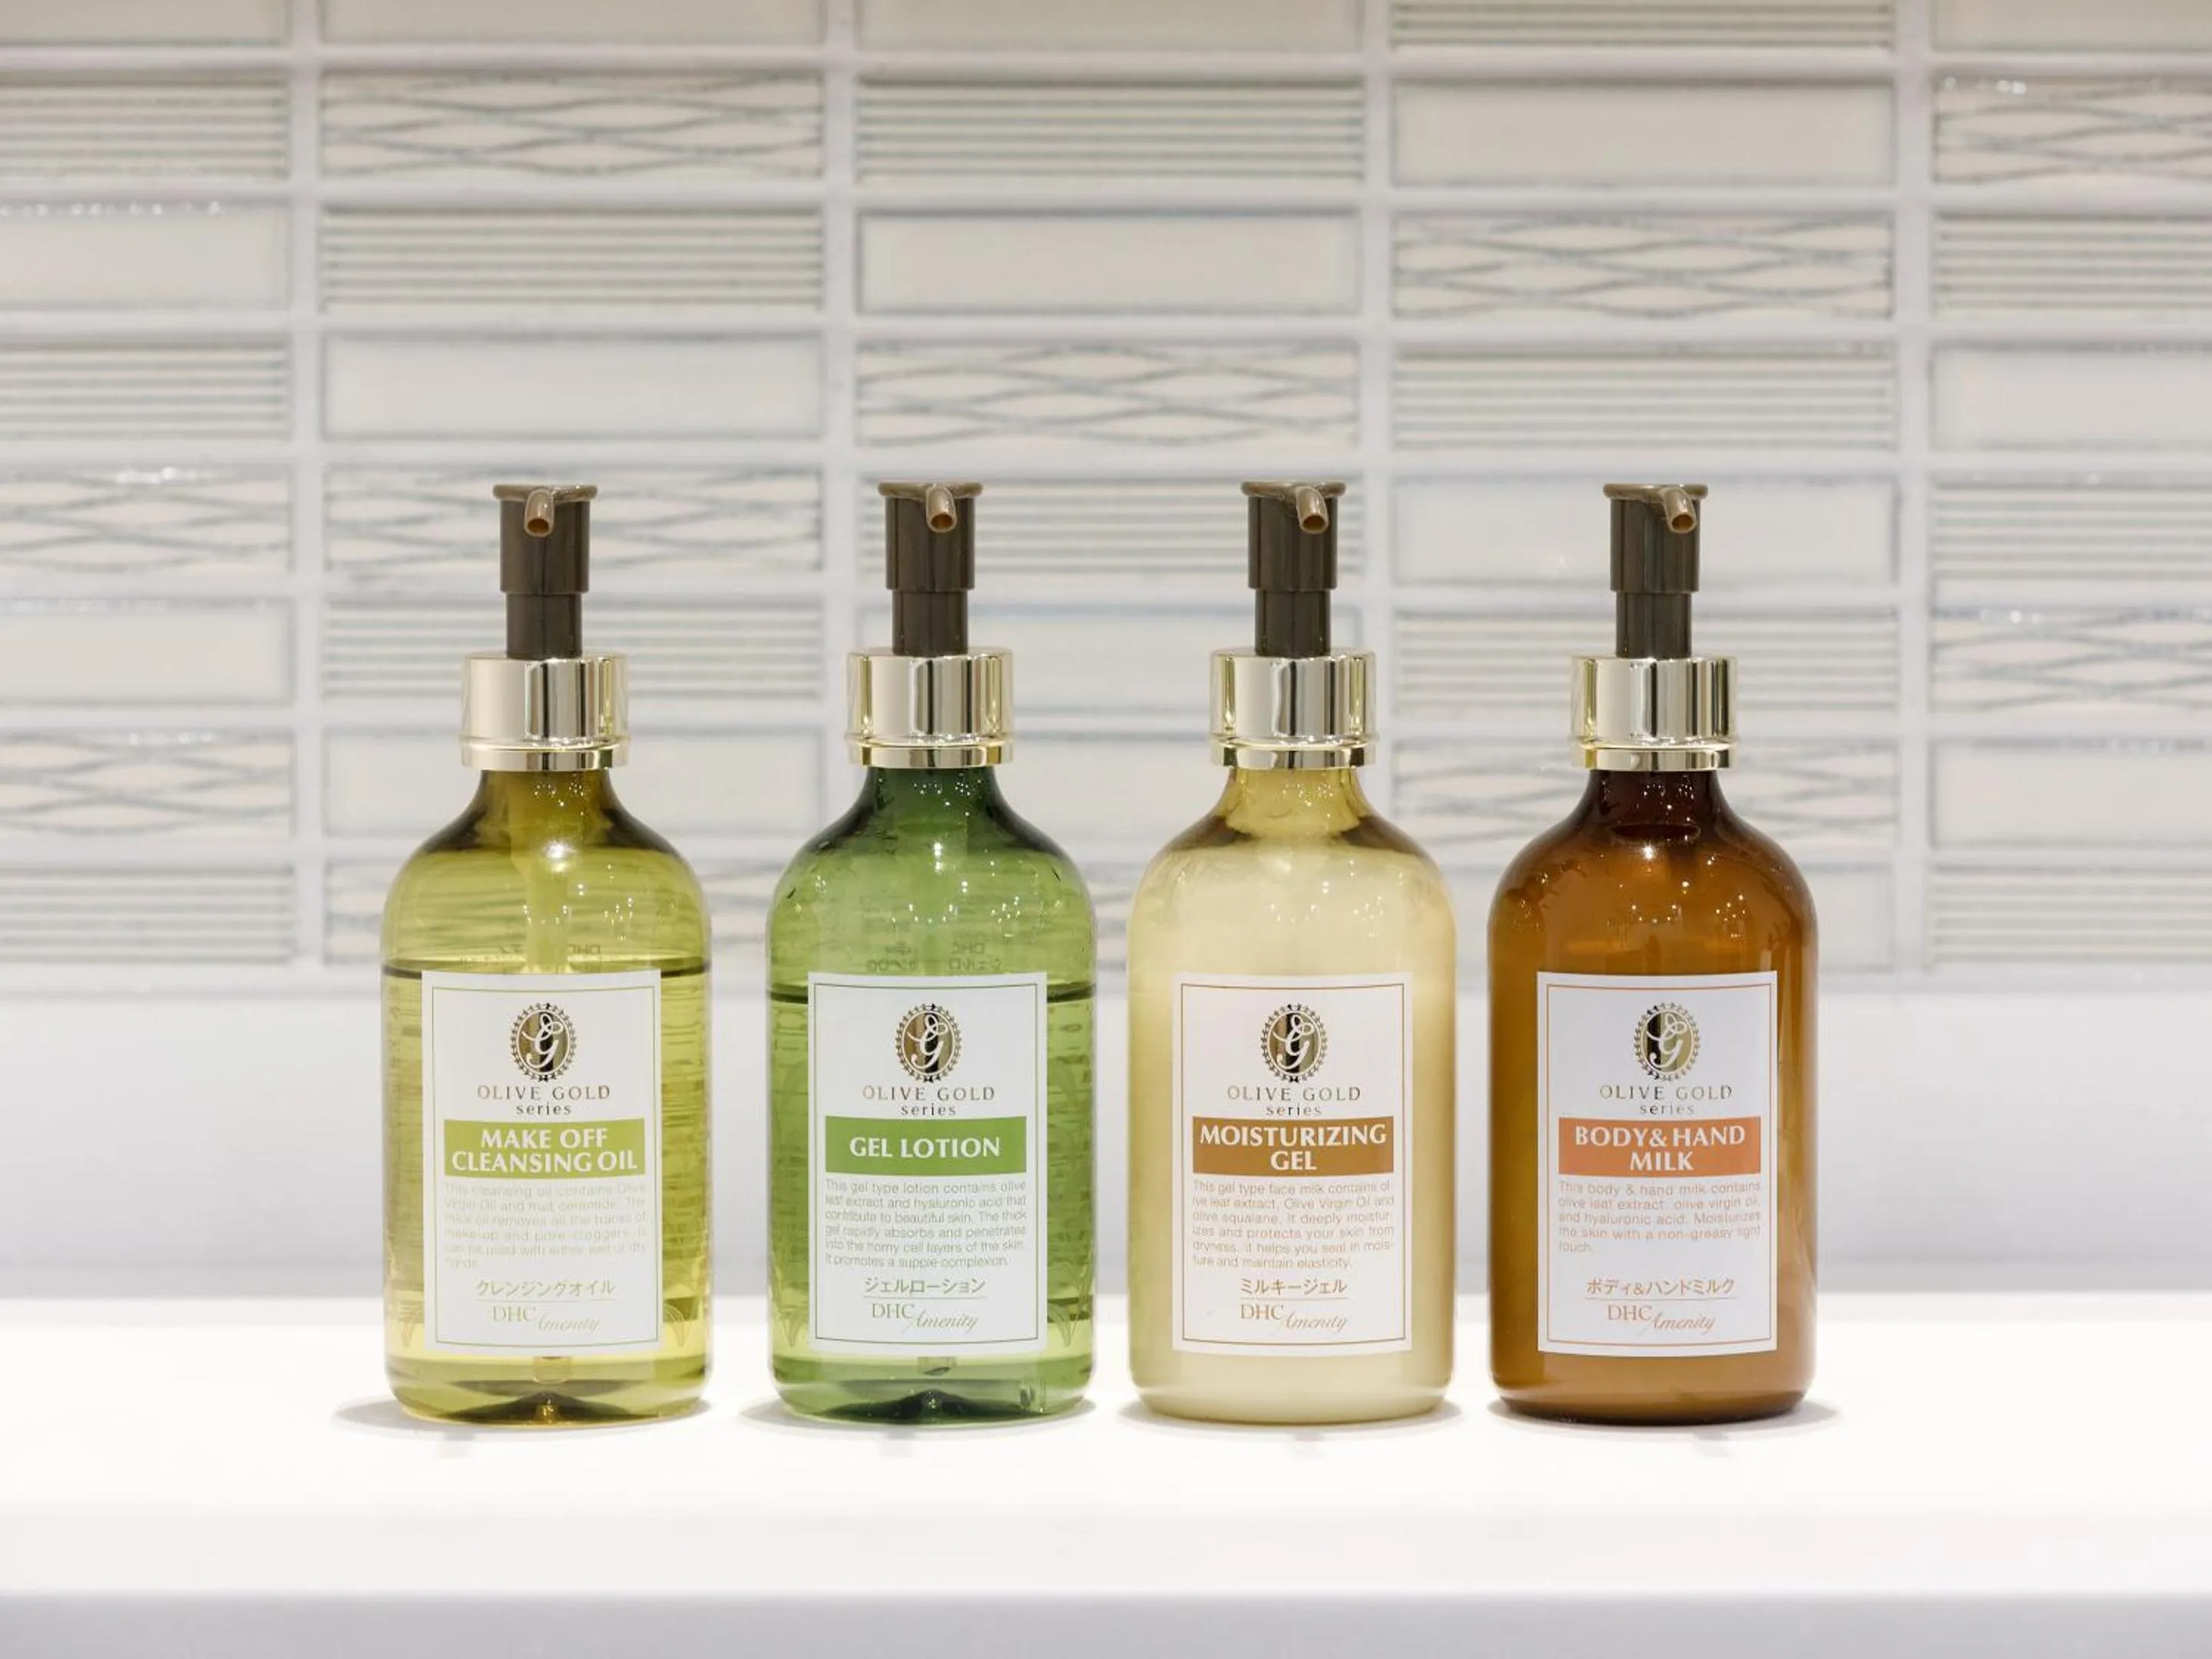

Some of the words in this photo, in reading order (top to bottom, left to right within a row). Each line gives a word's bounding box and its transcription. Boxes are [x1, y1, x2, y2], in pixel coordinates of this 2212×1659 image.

[477, 1084, 541, 1100] OLIVE
[552, 1084, 611, 1101] GOLD
[862, 1085, 926, 1101] OLIVE
[937, 1086, 995, 1101] GOLD
[1227, 1085, 1292, 1101] OLIVE
[1303, 1086, 1361, 1101] GOLD
[1598, 1084, 1664, 1100] OLIVE
[1675, 1084, 1733, 1100] GOLD
[516, 1101, 571, 1115] series
[901, 1102, 956, 1116] series
[1266, 1102, 1322, 1116] series
[1639, 1101, 1695, 1115] series
[481, 1128, 551, 1149] MAKE
[559, 1127, 608, 1149] OFF
[1200, 1124, 1387, 1147] MOISTURIZING
[849, 1136, 893, 1157] GEL
[900, 1137, 1002, 1159] LOTION
[452, 1150, 591, 1173] CLEANSING
[597, 1149, 637, 1171] OIL
[1270, 1151, 1318, 1171] GEL
[1630, 1151, 1694, 1171] MILK
[850, 1182, 868, 1194] gel
[872, 1183, 899, 1196] type
[903, 1182, 939, 1194] lotion
[943, 1184, 996, 1194] contains
[1001, 1181, 1026, 1192] olive
[1217, 1182, 1235, 1195] gel
[1239, 1183, 1265, 1196] type
[1269, 1183, 1295, 1194] face
[1300, 1183, 1324, 1194] milk
[1588, 1183, 1620, 1197] body
[1626, 1183, 1634, 1196] &
[1640, 1183, 1674, 1197] hand
[1679, 1183, 1705, 1194] milk
[1710, 1181, 1760, 1194] contains
[846, 1197, 882, 1208] extract
[888, 1197, 909, 1209] and
[914, 1196, 975, 1210] hyaluronic
[979, 1197, 1002, 1207] acid
[1006, 1195, 1026, 1206] that
[1284, 1197, 1314, 1210] Olive
[1374, 1195, 1394, 1207] and
[1558, 1197, 1587, 1208] olive
[1674, 1199, 1704, 1210] olive
[1707, 1197, 1741, 1211] virgin
[881, 1212, 892, 1223] to
[895, 1211, 944, 1224] beautiful
[979, 1210, 999, 1223] The
[1192, 1210, 1218, 1222] olive
[1300, 1212, 1341, 1226] deeply
[1558, 1211, 1581, 1223] and
[1584, 1211, 1651, 1226] hyaluronic
[884, 1227, 935, 1239] absorbs
[939, 1227, 962, 1238] and
[966, 1226, 1026, 1239] penetrates
[1219, 1227, 1243, 1238] and
[1247, 1228, 1301, 1241] protects
[1306, 1229, 1335, 1241] your
[1339, 1227, 1365, 1238] skin
[1369, 1226, 1394, 1237] from
[1558, 1226, 1578, 1237] the
[1581, 1227, 1607, 1239] skin
[1613, 1228, 1641, 1240] with
[1645, 1230, 1654, 1240] a
[846, 1239, 864, 1250] the
[927, 1241, 962, 1256] layers
[965, 1241, 978, 1253] of
[981, 1240, 1000, 1252] the
[1256, 1242, 1290, 1255] helps
[1294, 1244, 1318, 1257] you
[1322, 1241, 1346, 1253] seal
[1349, 1241, 1360, 1252] in
[1217, 1257, 1238, 1268] and
[475, 1279, 617, 1297] クレンジングオイル
[863, 1277, 987, 1295] ジェルローション
[1240, 1277, 1349, 1296] ミルキージェル
[492, 1305, 537, 1322] DHC
[872, 1303, 915, 1320] DHC
[1240, 1303, 1283, 1320] DHC
[1608, 1304, 1653, 1321] DHC
[1647, 1310, 1717, 1335] Amenity
